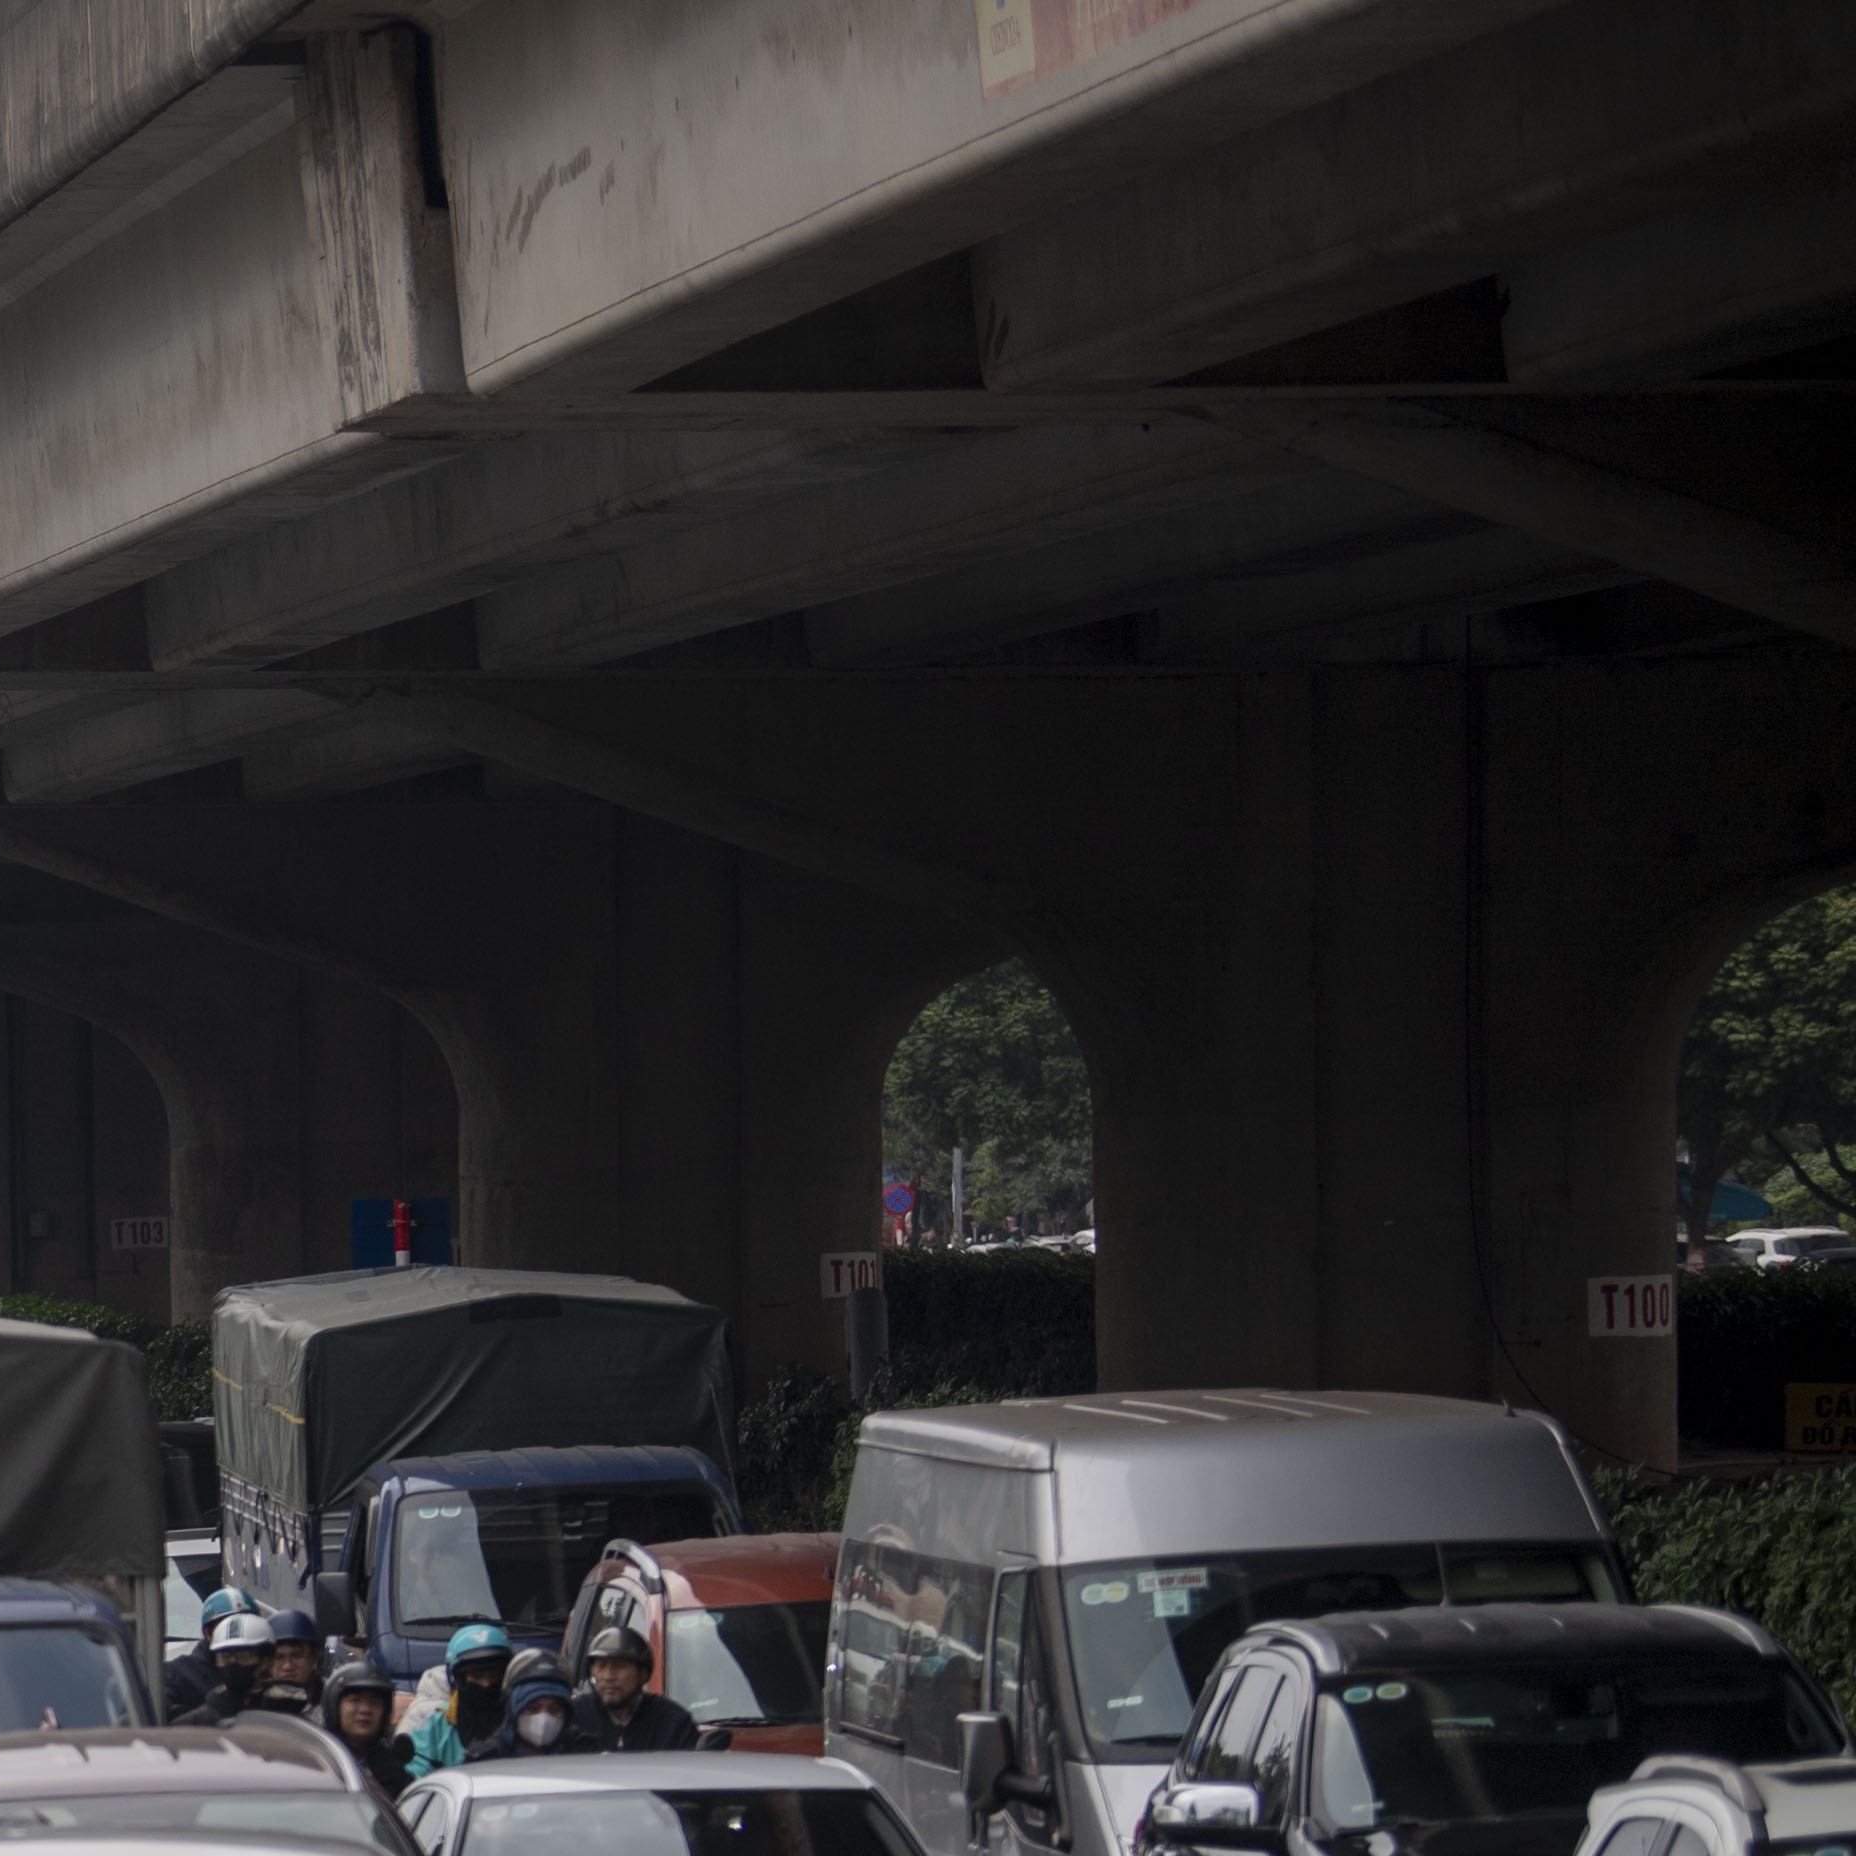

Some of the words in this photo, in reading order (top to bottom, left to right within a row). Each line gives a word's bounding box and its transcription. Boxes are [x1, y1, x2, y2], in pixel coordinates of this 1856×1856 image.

[830, 1259, 876, 1292] T101
[1600, 1283, 1669, 1329] T100
[1816, 1388, 1856, 1418] CẤ
